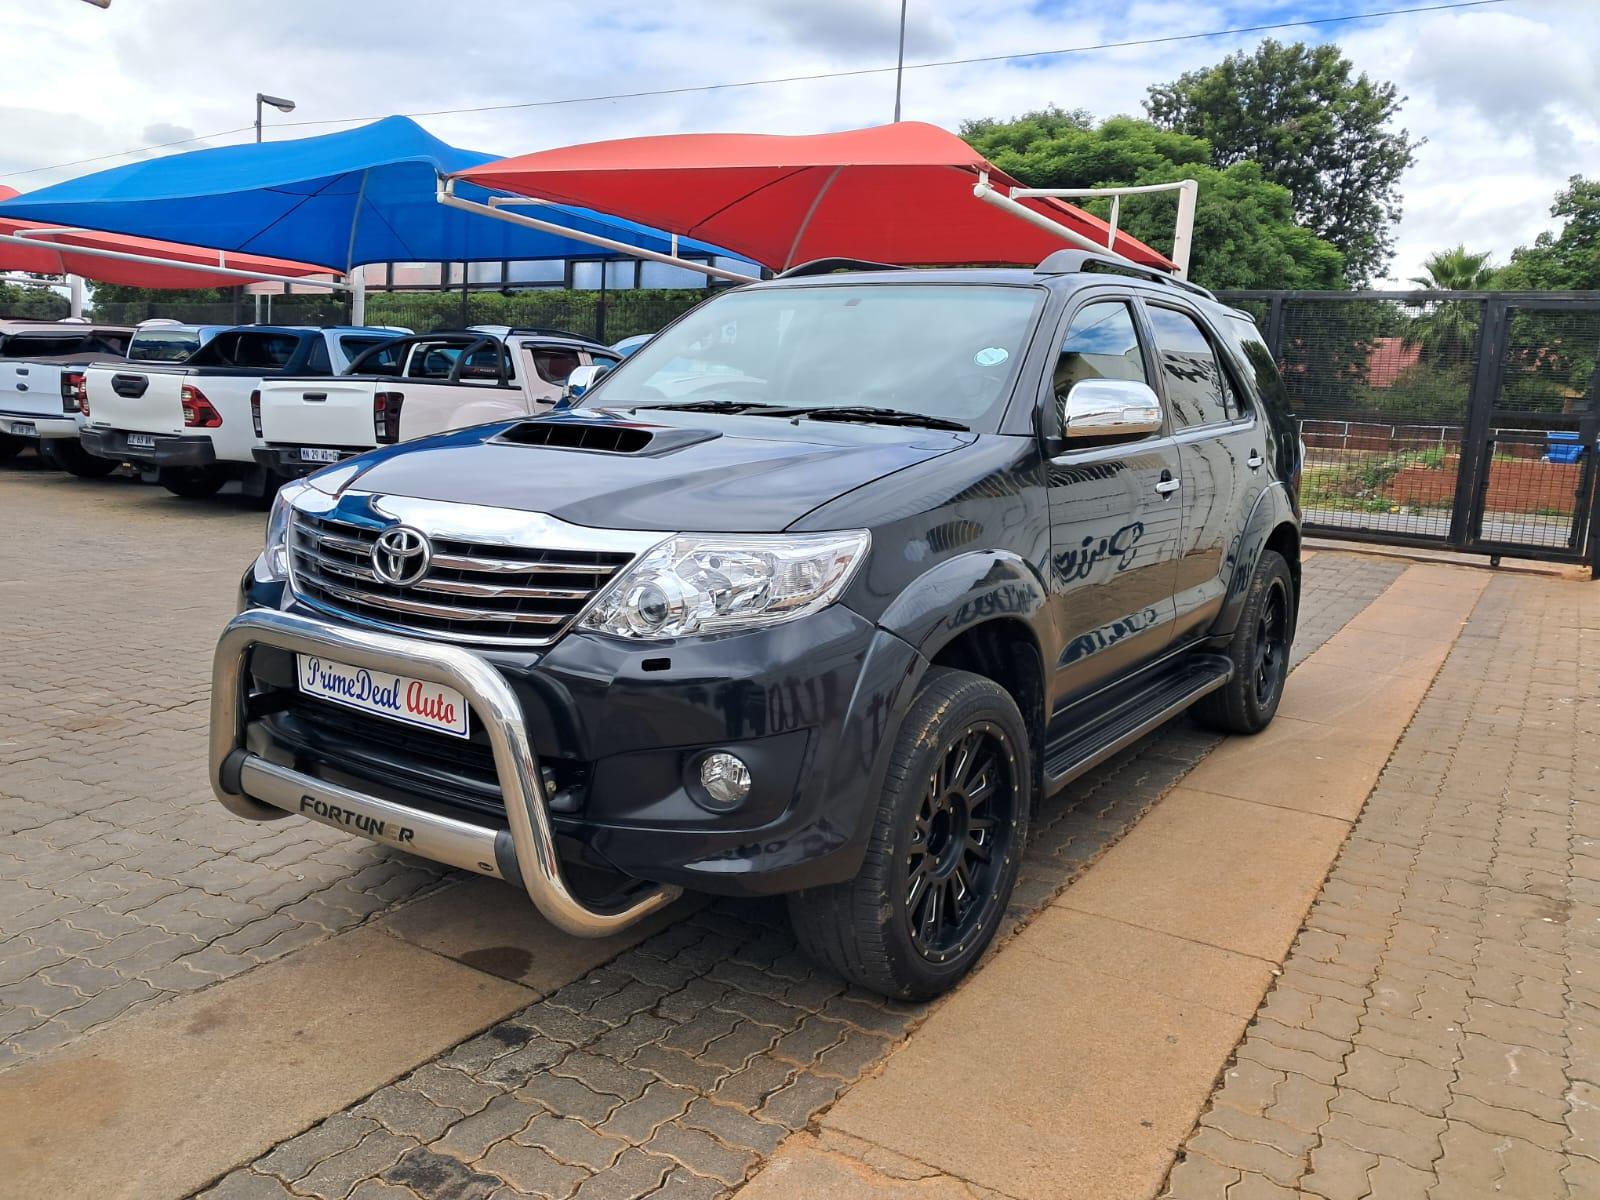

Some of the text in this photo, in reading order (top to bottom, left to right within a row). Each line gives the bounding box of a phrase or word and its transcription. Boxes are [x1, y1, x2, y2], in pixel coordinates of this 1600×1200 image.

[311, 449, 319, 460] 29
[307, 656, 457, 724] PrimeDeal Auto
